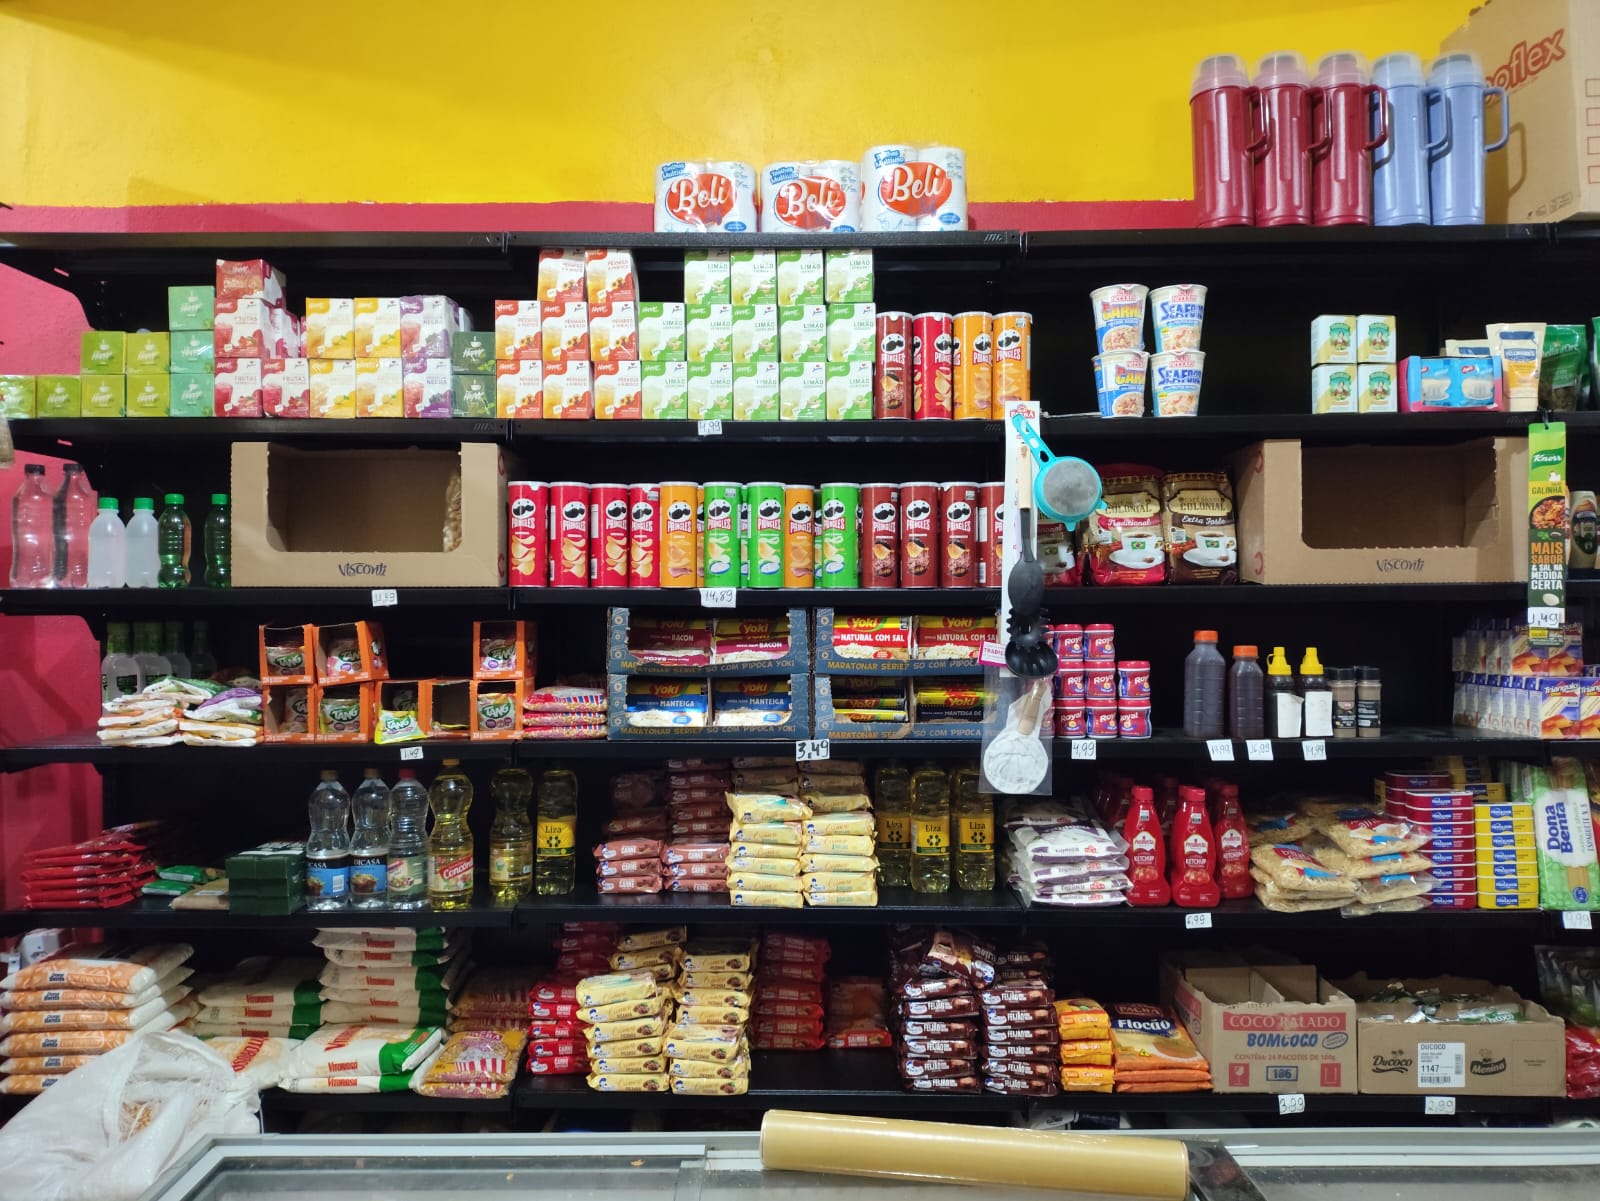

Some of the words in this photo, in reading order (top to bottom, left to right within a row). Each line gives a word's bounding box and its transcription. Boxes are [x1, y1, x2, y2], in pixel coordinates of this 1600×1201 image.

[887, 164, 942, 203] Beli
[671, 175, 729, 215] Beli
[779, 178, 840, 217] Beli
[881, 353, 906, 365] PRINGLES
[996, 348, 1021, 362] PRINGLES
[1532, 453, 1562, 464] Knorr
[1532, 485, 1563, 495] GALINHA
[1179, 502, 1226, 512] COLONIAL
[511, 518, 536, 529] PRINGLES
[562, 520, 586, 532] PRINGLES
[707, 517, 732, 531] PRINGLES
[757, 518, 781, 530] PRINGLES
[906, 519, 931, 531] PRINGLES
[946, 520, 971, 532] PRINGLES
[1181, 515, 1203, 525] Extra
[667, 520, 692, 533] PRINGLES
[873, 521, 896, 533] PRINGLES
[1531, 541, 1563, 554] MAIS
[1376, 557, 1425, 573] Visconti
[1531, 554, 1563, 564] SABOR
[338, 563, 387, 577] Visconti
[1531, 570, 1563, 580] MEDIDA
[1531, 579, 1563, 590] CERTA
[743, 623, 769, 634] Yoki
[671, 634, 694, 642] BACON
[841, 633, 873, 642] NATURAL
[875, 633, 891, 642] COM
[893, 633, 905, 642] SAL
[936, 634, 969, 642] NATURAL
[971, 634, 986, 642] COM
[278, 655, 303, 669] TANG
[721, 663, 739, 671] COM
[742, 661, 773, 670] PIPOCA
[776, 659, 795, 668] YOKI
[827, 661, 878, 671] MARATONAR
[928, 660, 947, 668] COM
[950, 659, 980, 668] PIPOCA
[653, 685, 680, 696] Yoki
[743, 683, 768, 695] Yoki
[660, 700, 695, 708] MANTEIGA
[333, 708, 359, 722] TANG
[483, 704, 510, 717] TANG
[1061, 711, 1082, 722] Royal
[386, 718, 411, 732] TANG
[721, 725, 739, 733] COM
[743, 725, 774, 733] PIPOCA
[778, 725, 796, 733] YOKI
[929, 729, 947, 737] COM
[951, 728, 981, 737] PIPOCA
[545, 825, 562, 834] Liza
[886, 820, 902, 830] Liza
[925, 824, 941, 833] Liza
[969, 821, 986, 831] Liza
[1545, 805, 1561, 850] Dona
[1555, 801, 1573, 853] Benta
[621, 846, 637, 854] CARNE
[688, 852, 704, 860] CARNE
[691, 865, 707, 874] CARNE
[619, 879, 634, 888] CARNE
[1118, 1017, 1172, 1030] Flocão
[1229, 1014, 1276, 1029] COCO
[1247, 1032, 1319, 1048] BOMCOCO
[1421, 1064, 1440, 1073] 1147
